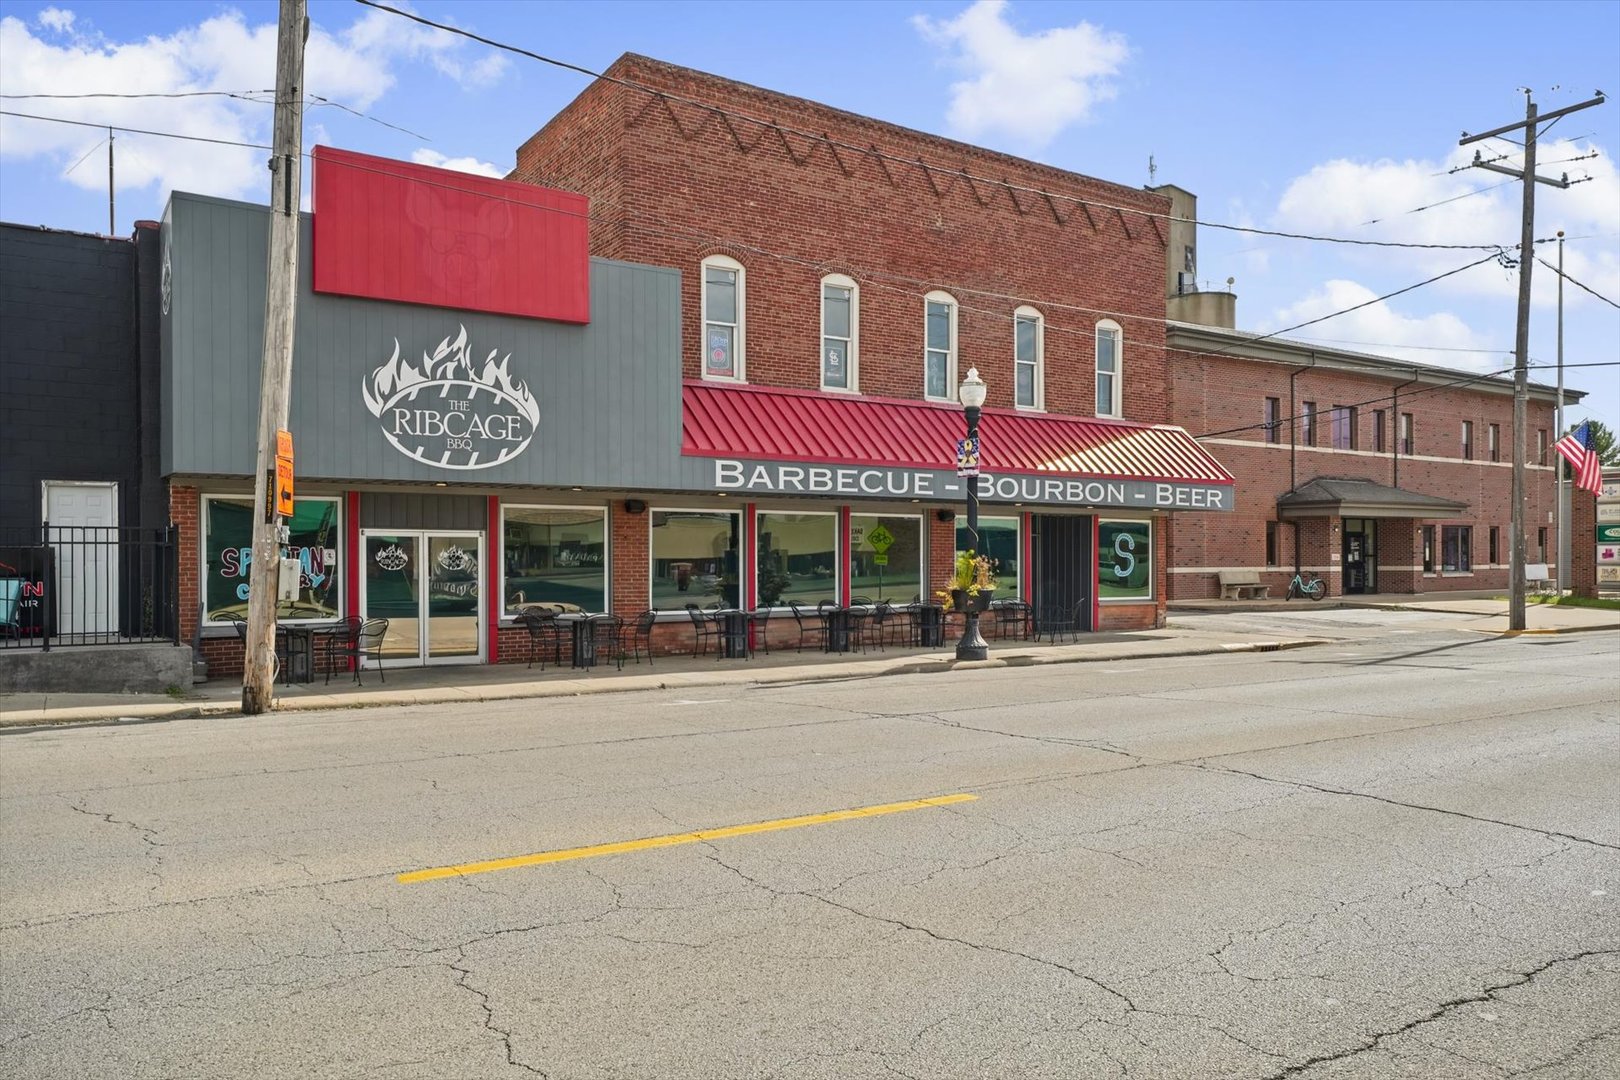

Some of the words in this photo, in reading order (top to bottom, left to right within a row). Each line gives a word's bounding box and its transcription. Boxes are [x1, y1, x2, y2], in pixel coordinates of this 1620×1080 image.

[448, 400, 470, 412] THE
[392, 407, 523, 442] RIBCAGE
[446, 438, 473, 452] BBQ
[715, 459, 934, 495] BARBECUE
[1155, 484, 1222, 507] BEER
[1114, 532, 1135, 577] S
